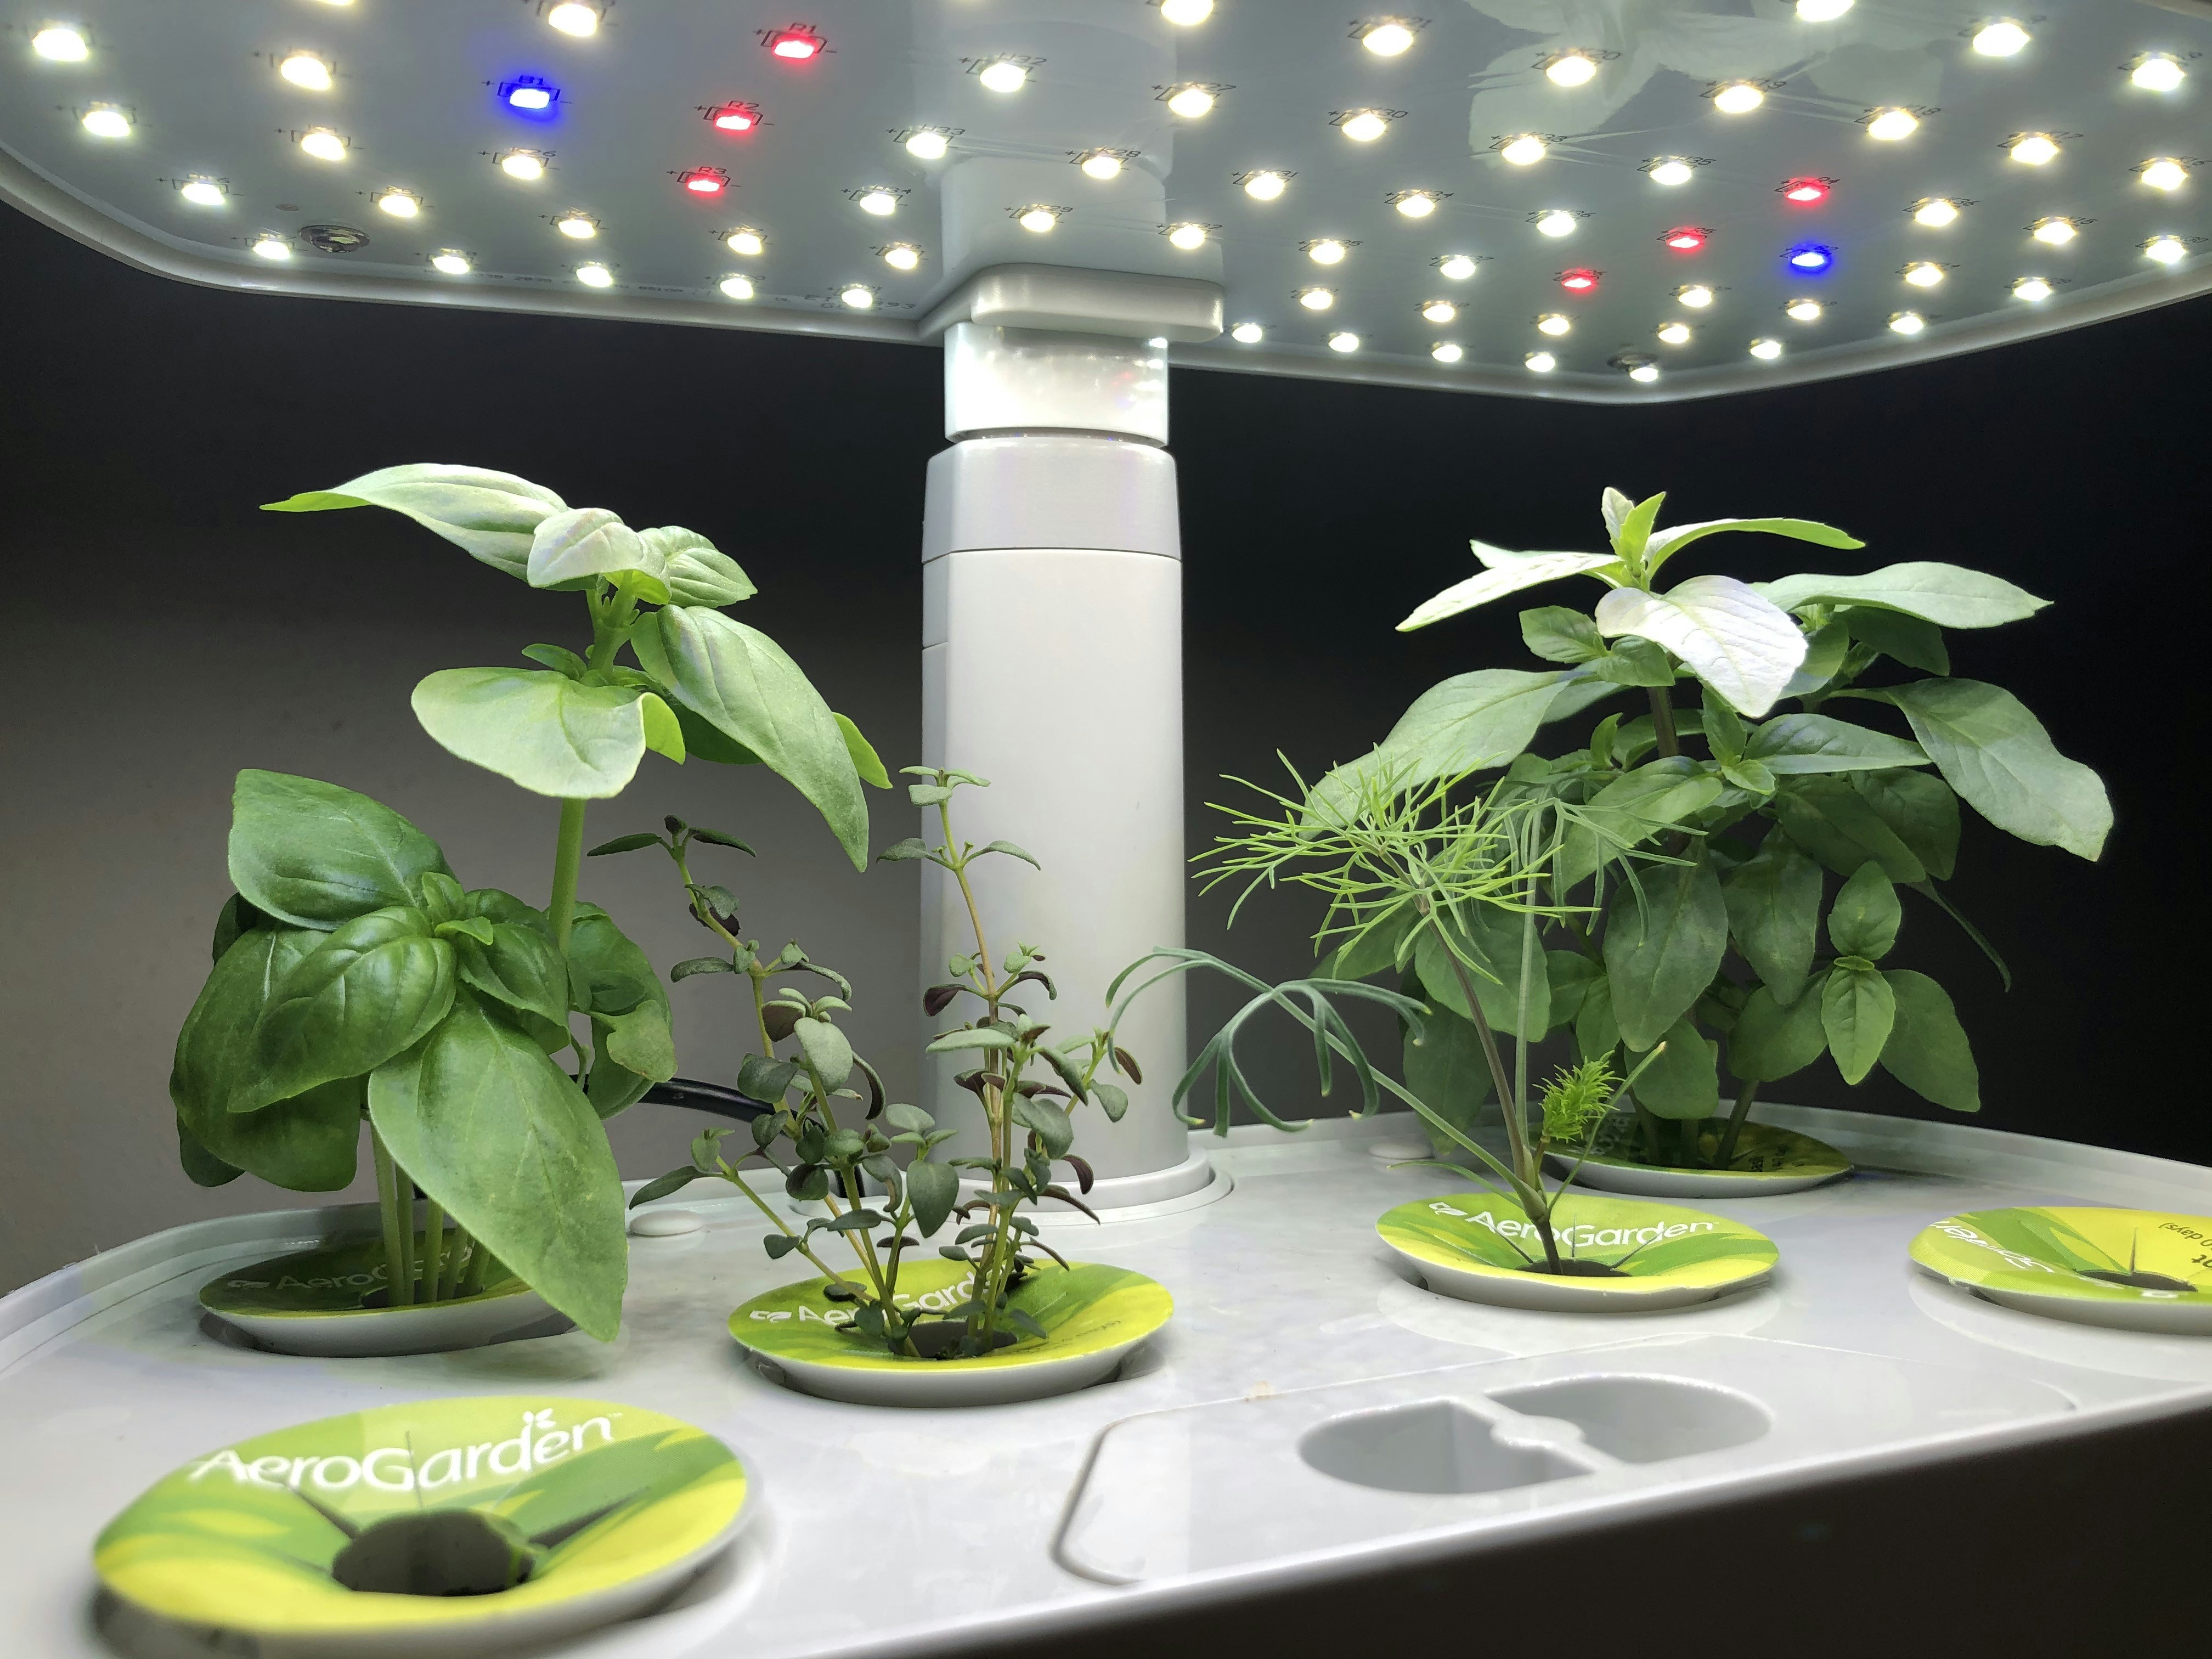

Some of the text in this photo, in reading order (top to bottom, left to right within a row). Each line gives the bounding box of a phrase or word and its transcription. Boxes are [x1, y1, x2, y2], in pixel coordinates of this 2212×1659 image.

[789, 22, 817, 35] R1
[995, 52, 1047, 65] H32
[518, 75, 544, 86] B1
[727, 100, 758, 111] R2
[920, 124, 966, 136] H33
[1098, 144, 1142, 157] K28
[698, 166, 727, 174] R3
[871, 184, 912, 195] H34
[1415, 189, 1454, 198] K34
[1035, 203, 1074, 213] K29
[2158, 1222, 2203, 1239] days)
[188, 1408, 613, 1491] AeroGarden
